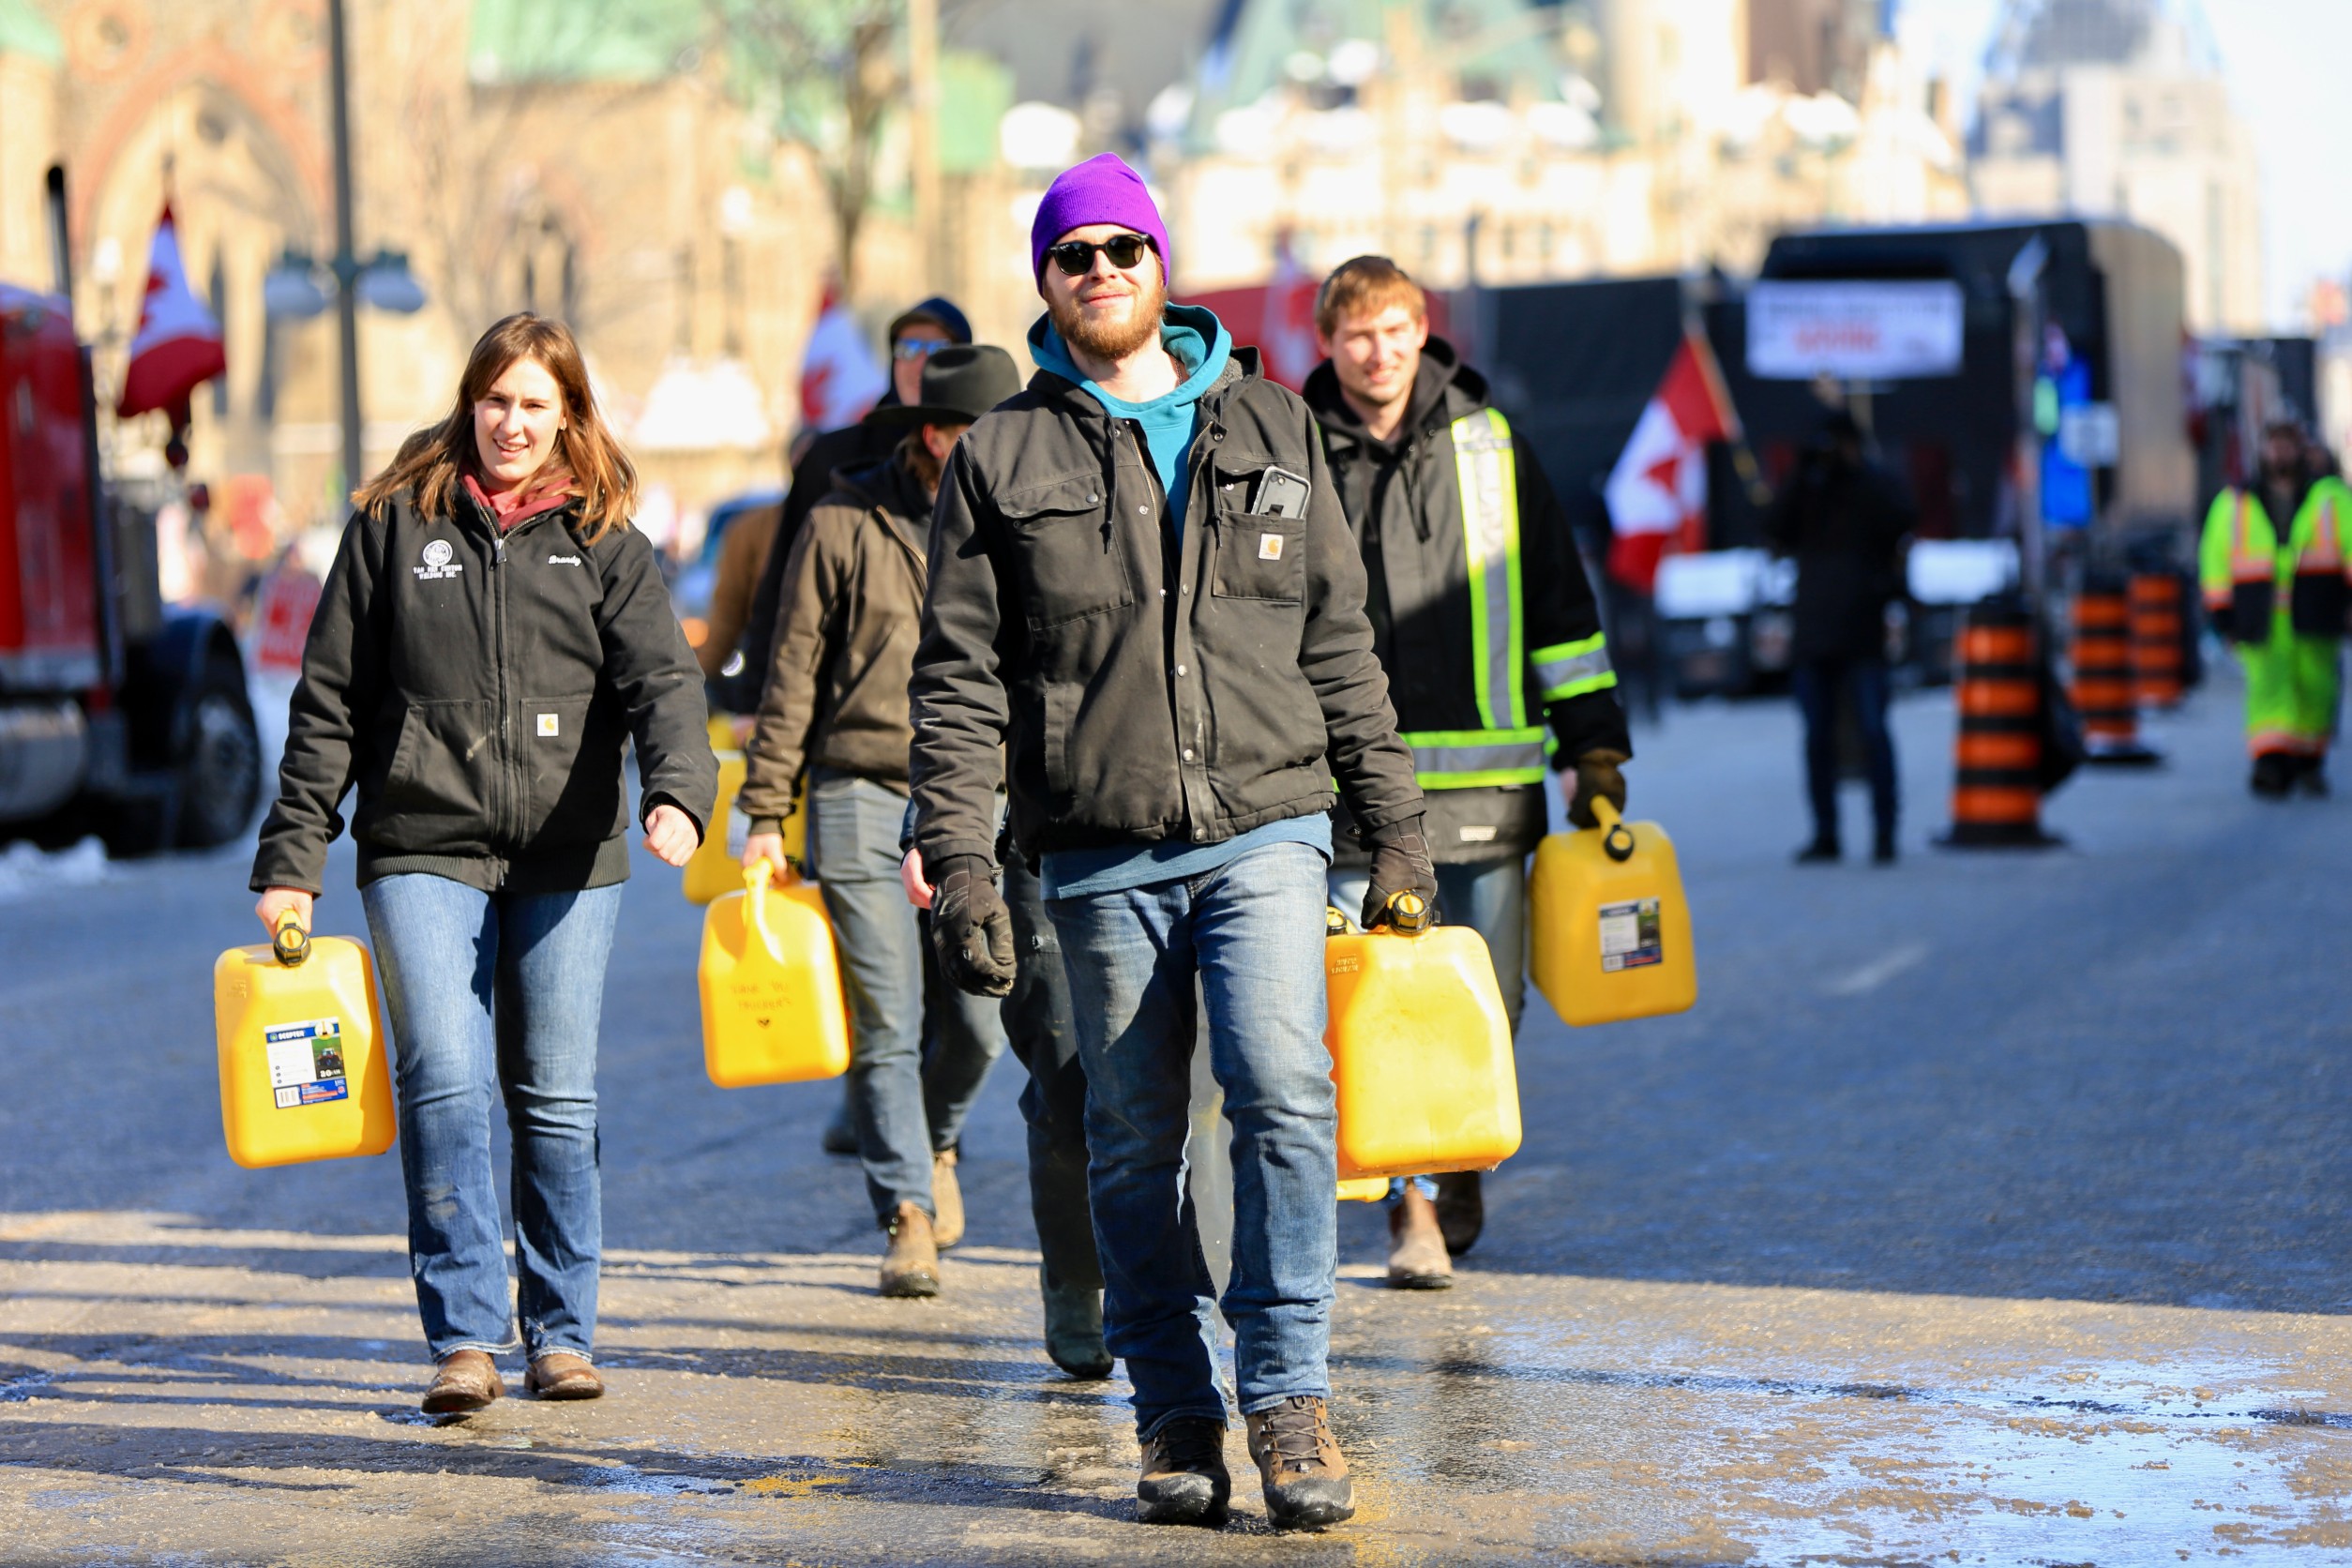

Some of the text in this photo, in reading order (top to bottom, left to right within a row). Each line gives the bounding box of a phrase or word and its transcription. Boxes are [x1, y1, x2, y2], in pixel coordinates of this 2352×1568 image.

[549, 555, 580, 566] Brandy
[418, 571, 444, 580] WELDING
[278, 1030, 305, 1040] SCEPTER
